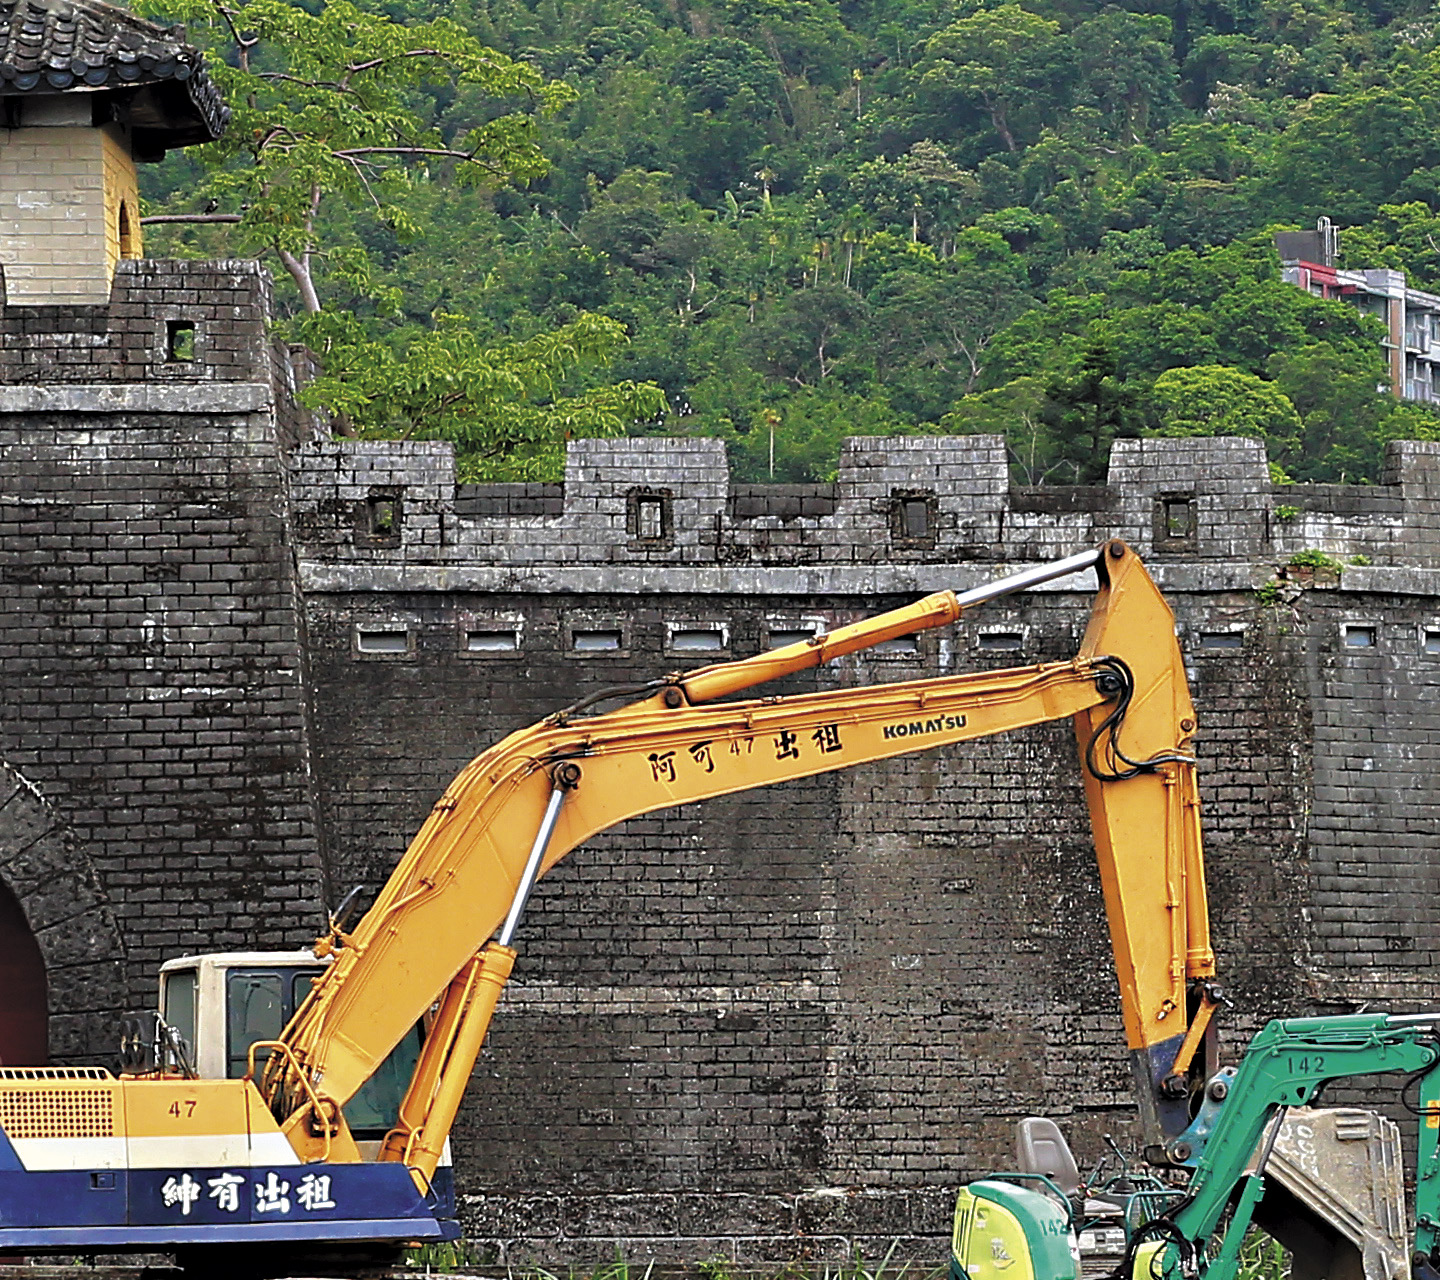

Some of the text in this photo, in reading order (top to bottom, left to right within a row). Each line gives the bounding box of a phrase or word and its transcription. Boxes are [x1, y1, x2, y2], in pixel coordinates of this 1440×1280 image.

[883, 714, 967, 739] KOMATSU
[730, 737, 754, 756] 47
[774, 723, 843, 760] 出租
[1288, 1056, 1325, 1074] 142
[168, 1101, 197, 1118] 47
[162, 1172, 336, 1215] 紳有出租
[1041, 1219, 1068, 1236] 142
